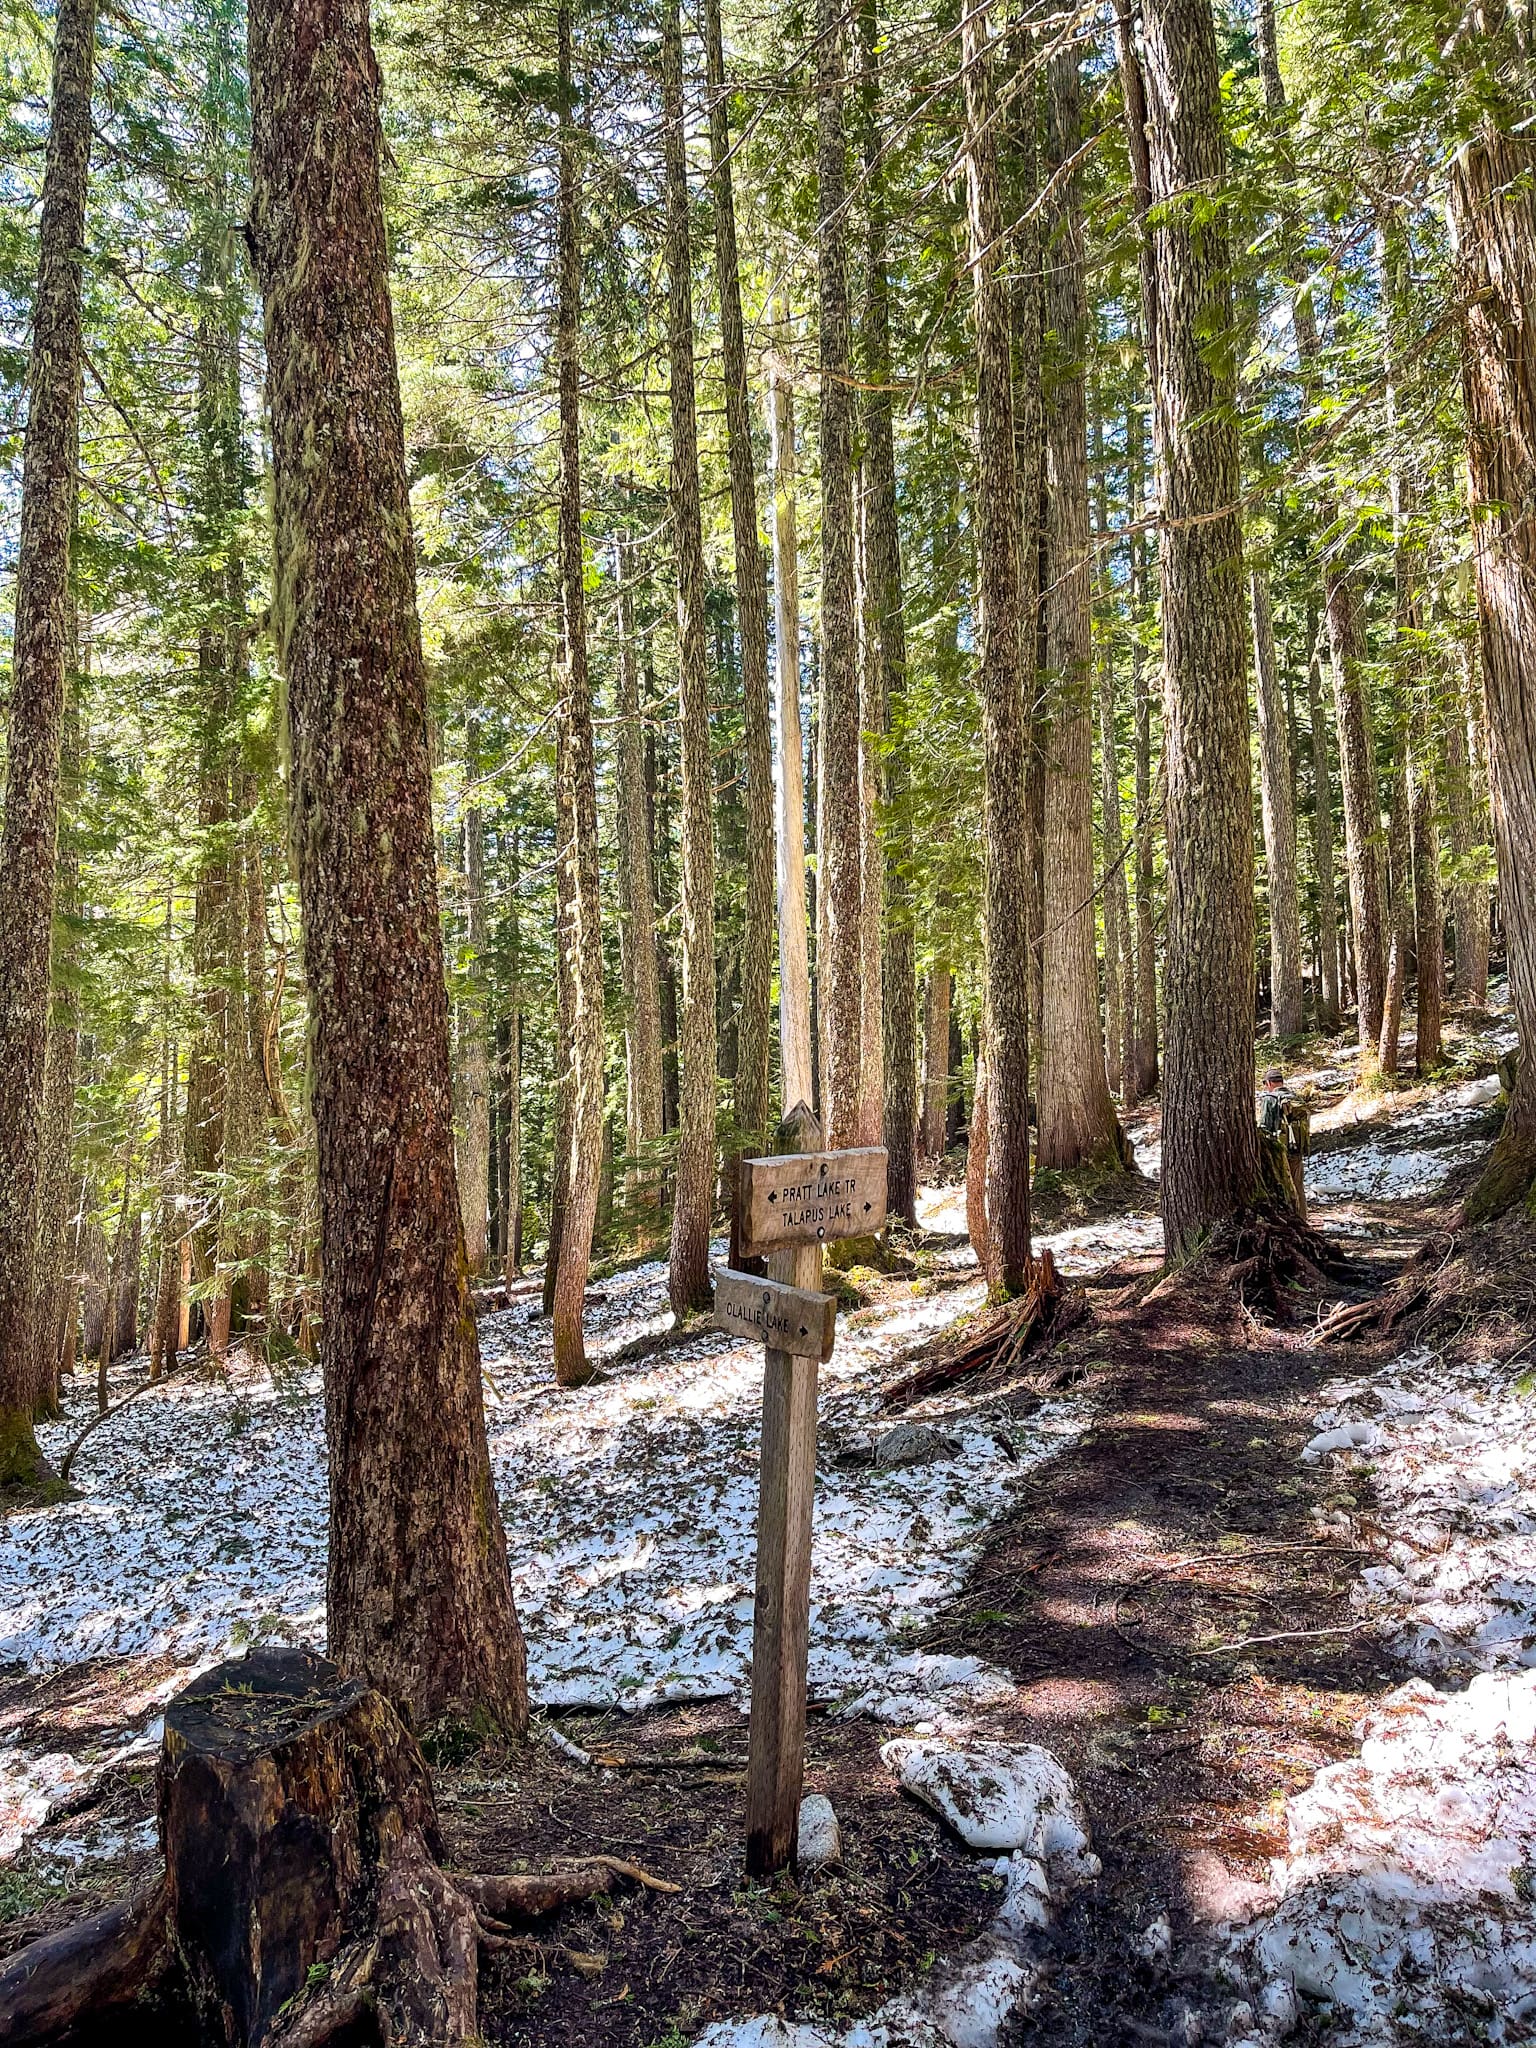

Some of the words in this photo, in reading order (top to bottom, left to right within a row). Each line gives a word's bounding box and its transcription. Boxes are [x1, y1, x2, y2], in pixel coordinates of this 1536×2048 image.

[782, 1184, 812, 1203] PRATT
[817, 1181, 840, 1198] LAKE
[846, 1179, 856, 1193] TR
[782, 1207, 824, 1227] TALAPUS
[829, 1202, 851, 1219] LAKE
[726, 1302, 762, 1325] OLALLIE
[765, 1313, 789, 1332] LAKE
